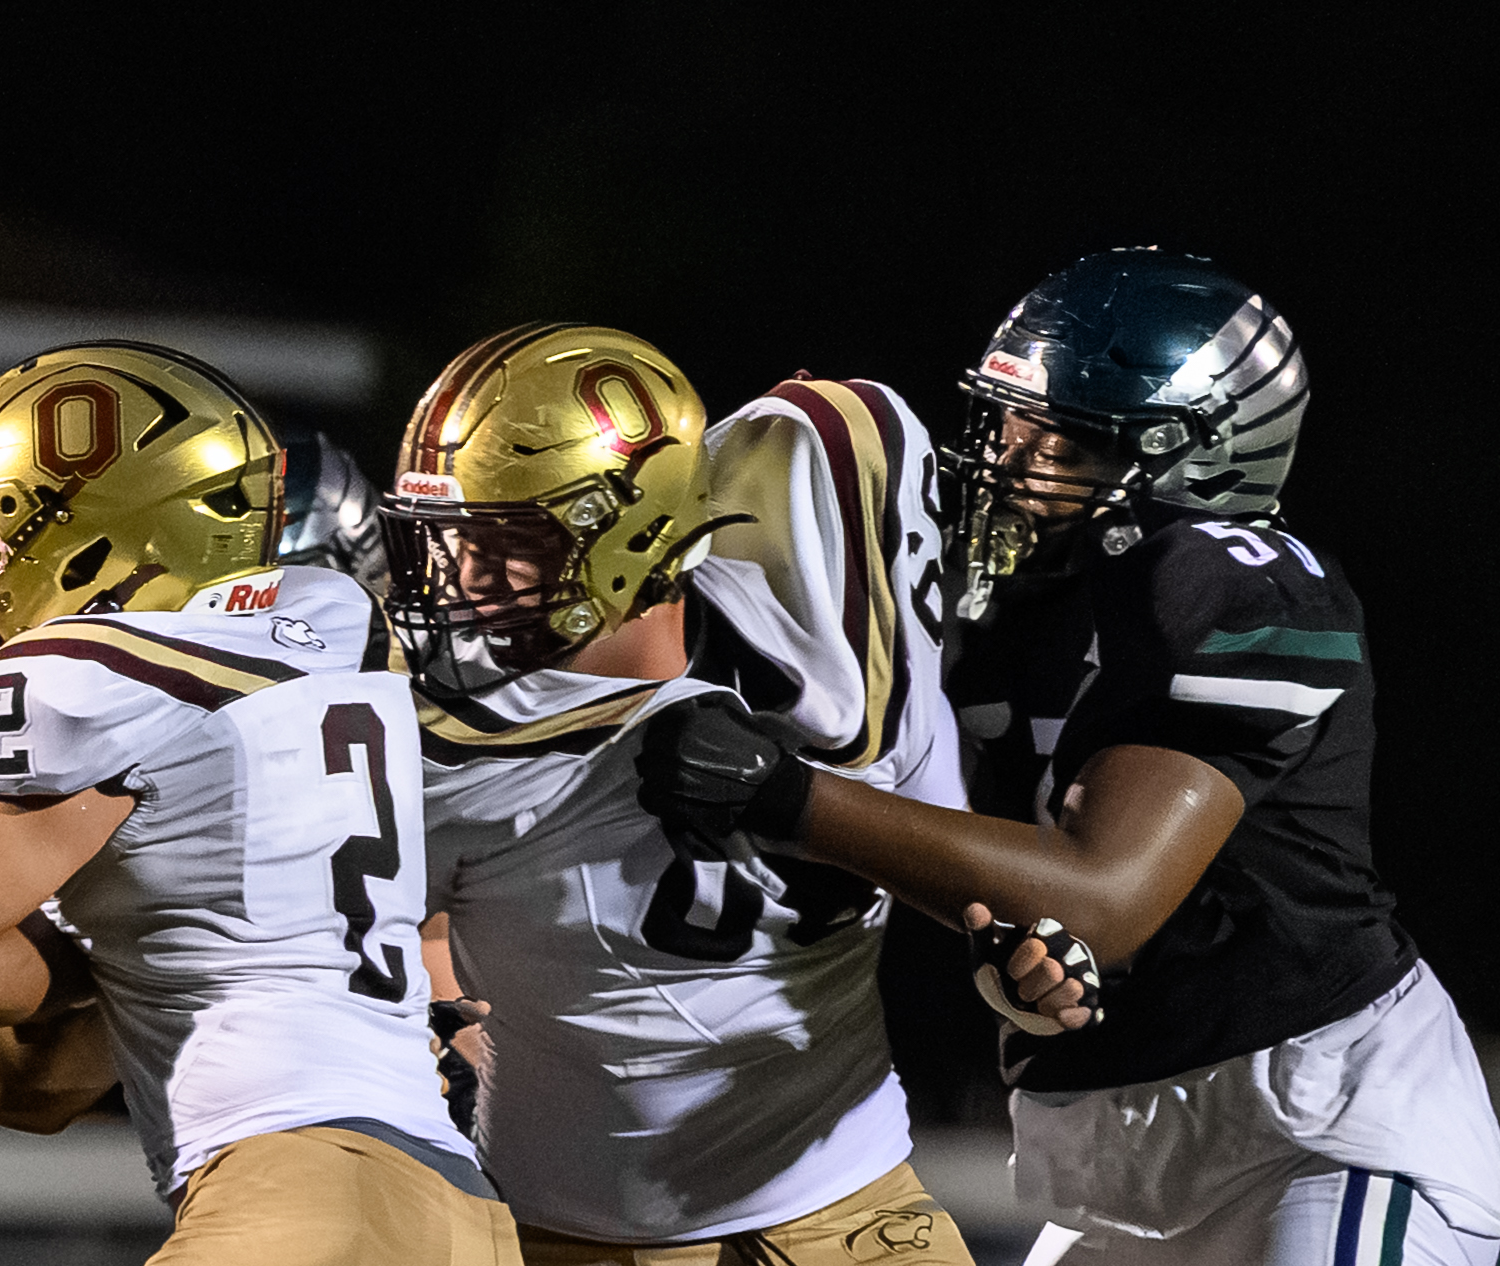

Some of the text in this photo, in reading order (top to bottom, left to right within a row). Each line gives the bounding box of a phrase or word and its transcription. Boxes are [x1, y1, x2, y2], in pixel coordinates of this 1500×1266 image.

[32, 379, 122, 482] O
[572, 358, 668, 460] O
[224, 581, 282, 613] Ridd
[319, 702, 409, 1003] 2
